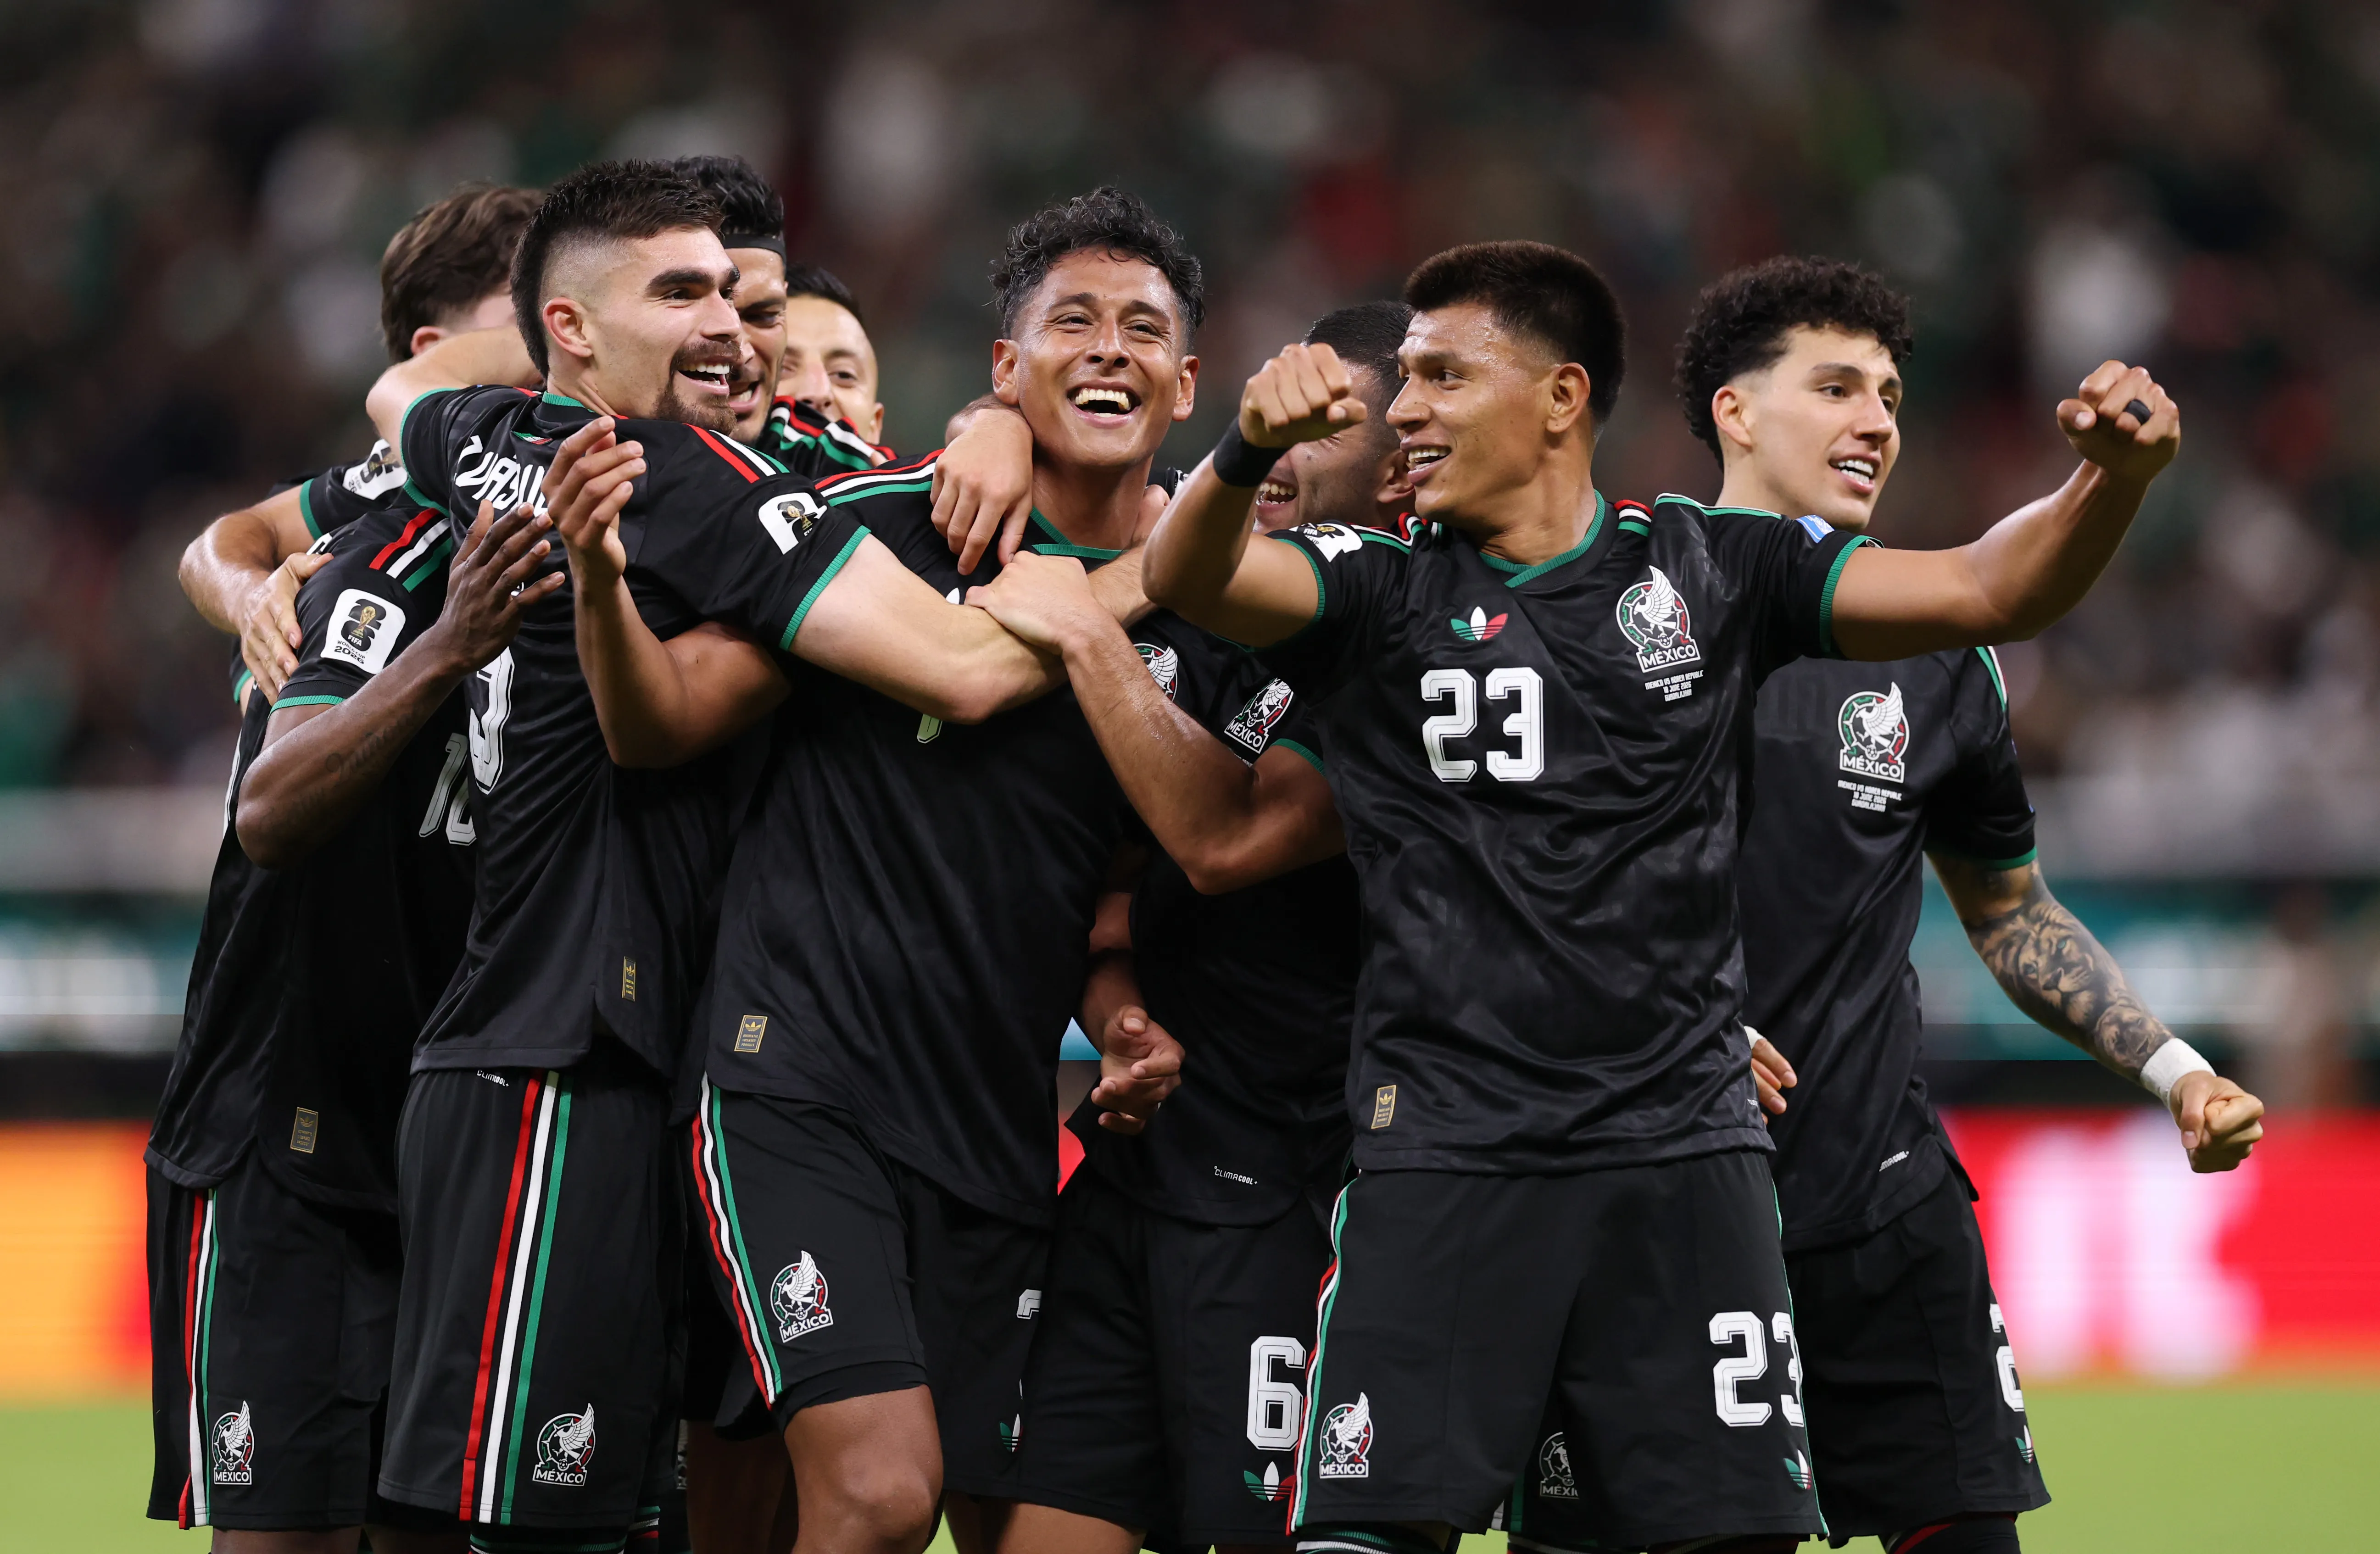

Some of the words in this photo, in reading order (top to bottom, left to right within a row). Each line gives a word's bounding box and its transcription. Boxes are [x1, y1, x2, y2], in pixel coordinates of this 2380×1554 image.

[337, 640, 355, 652] WORLD
[347, 635, 363, 646] FIFA
[334, 646, 364, 664] 2026
[1641, 645, 1695, 668] MÉXICO
[1644, 679, 1664, 690] MEXICO
[1670, 674, 1685, 684] KOREA
[1685, 670, 1704, 680] REPUBLIC
[1669, 683, 1680, 693] JUNE
[1680, 681, 1692, 690] 2026
[1664, 689, 1692, 702] GUADALAJARA
[1421, 667, 1544, 782] 23
[1227, 720, 1262, 747] MÉXICO
[1844, 754, 1901, 778] MÉXICO
[782, 1314, 829, 1339] MÉXICO
[1247, 1336, 1306, 1451] 6
[216, 1469, 249, 1482] MÉXICO
[1321, 1461, 1366, 1474] MÉXICO
[536, 1469, 584, 1483] MÉXICO
[1543, 1484, 1578, 1497] MÉXI
